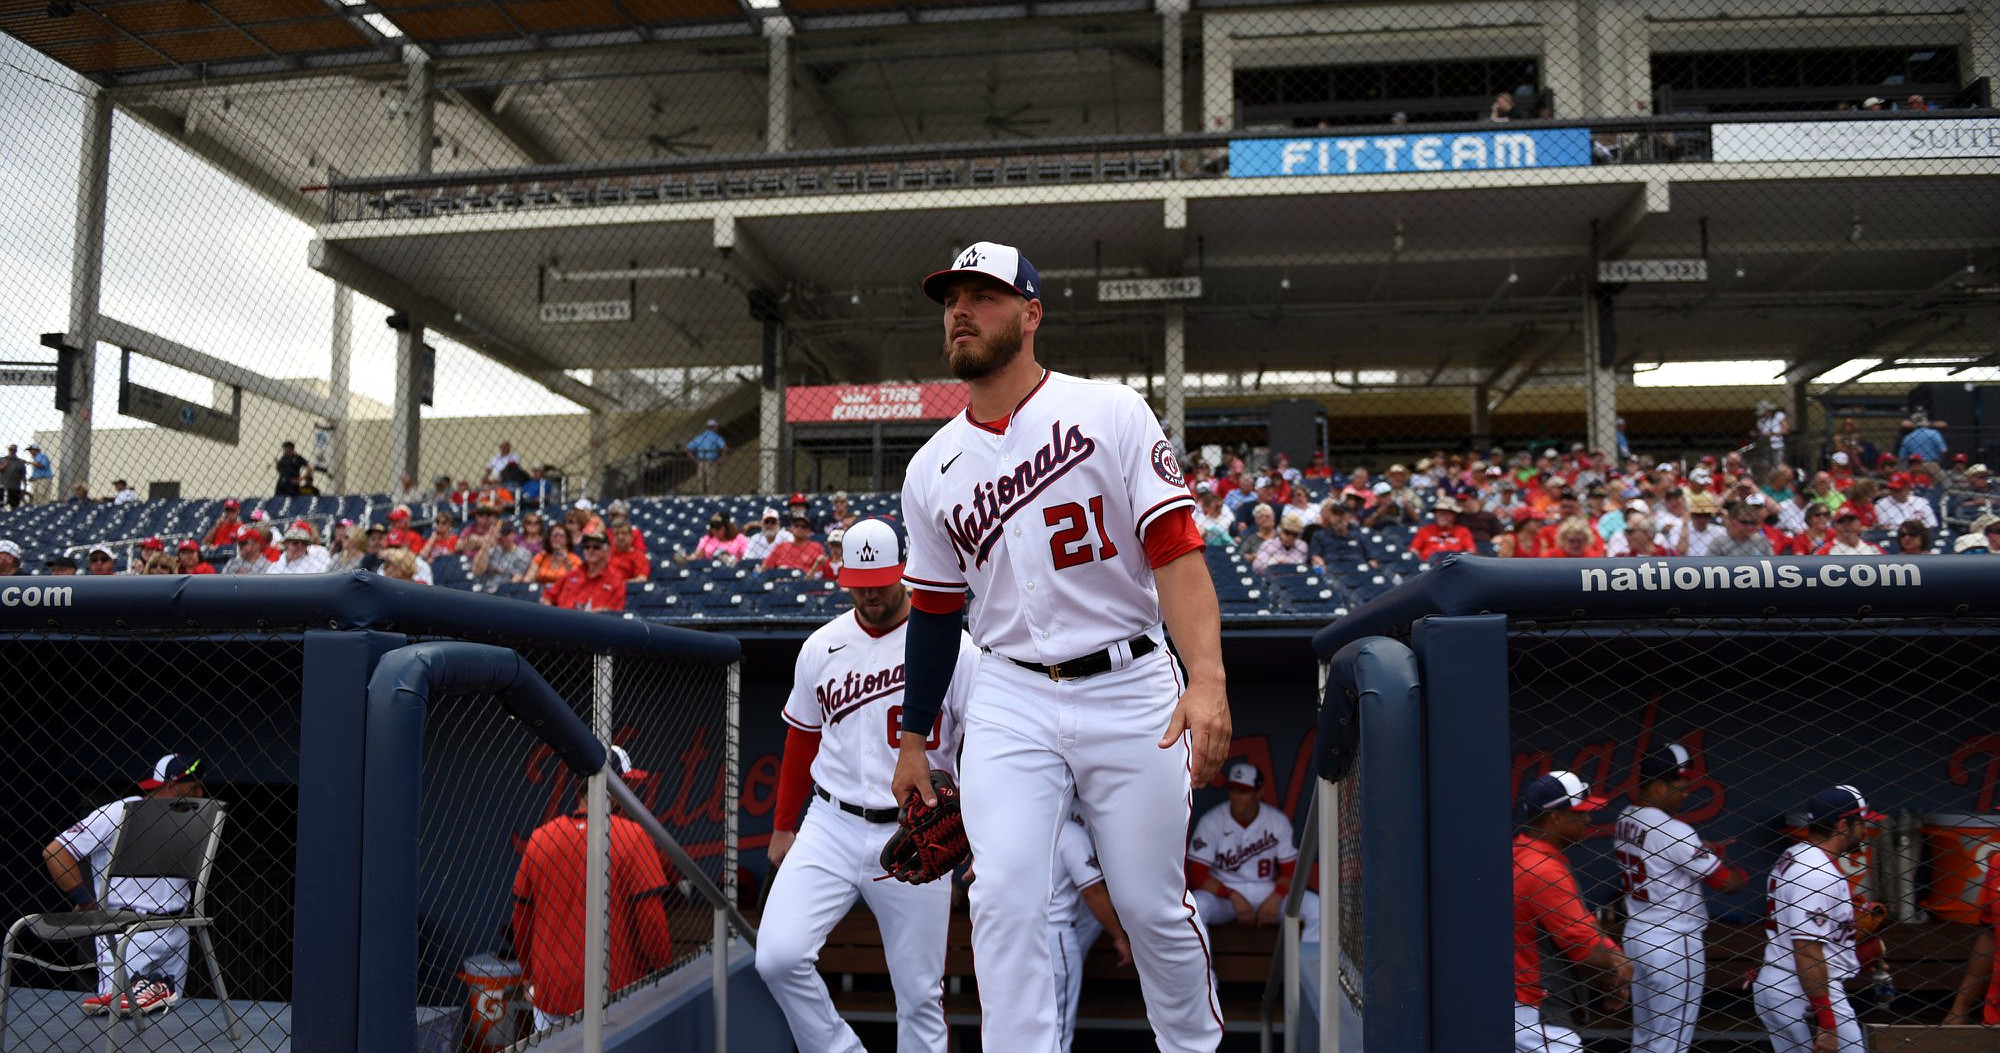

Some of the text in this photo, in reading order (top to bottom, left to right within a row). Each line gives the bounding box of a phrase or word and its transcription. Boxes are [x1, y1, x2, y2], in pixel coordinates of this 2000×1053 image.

[1282, 134, 1536, 173] FITTEAM
[831, 404, 924, 420] KINGDOM
[879, 387, 922, 403] TIRE
[944, 420, 1096, 573] Nationals
[1043, 494, 1119, 571] 21
[1580, 560, 1922, 592] nationals.com
[816, 664, 905, 727] Nationa
[1214, 830, 1279, 872] Nationals
